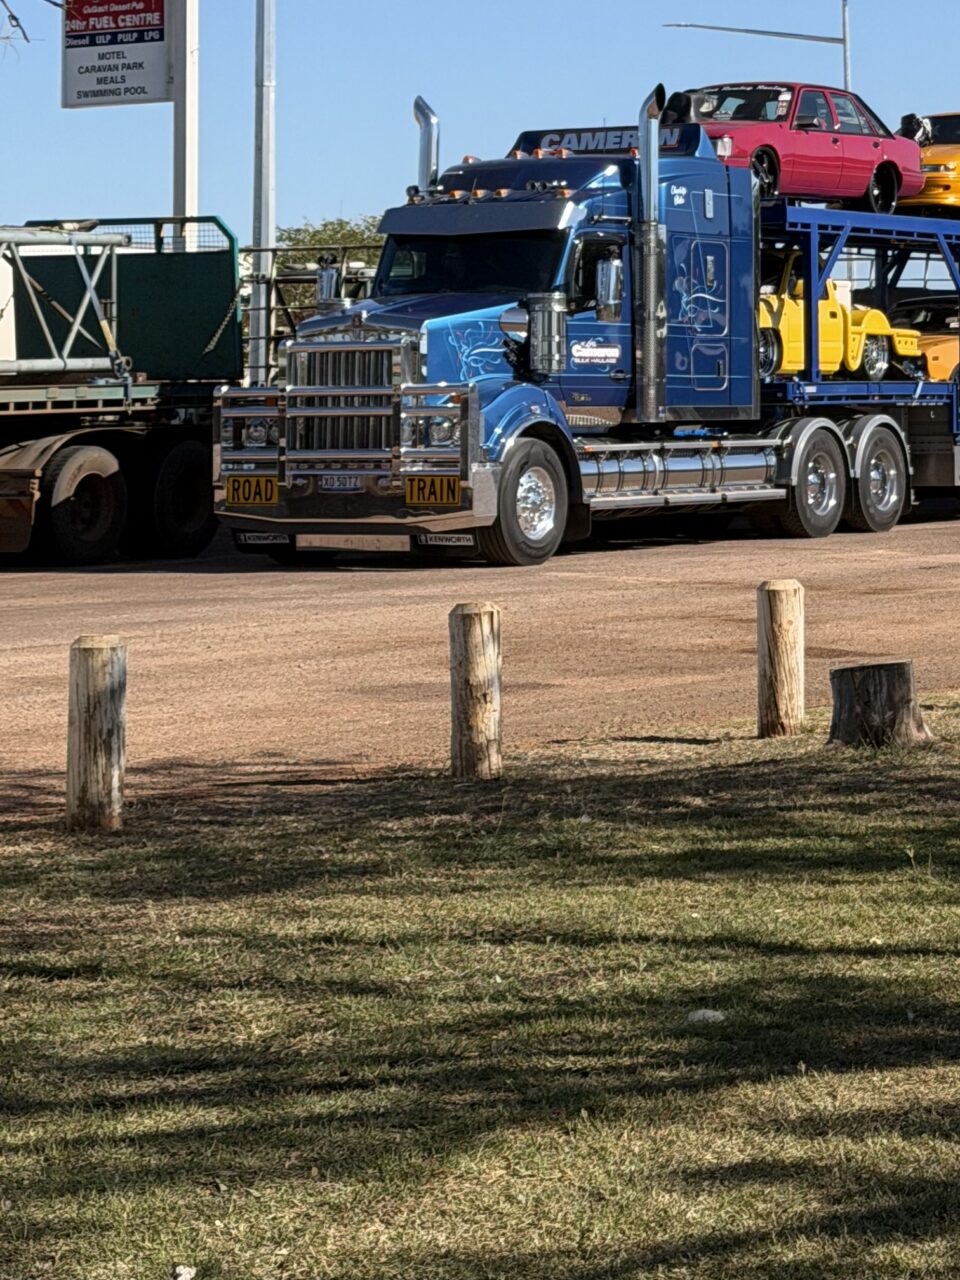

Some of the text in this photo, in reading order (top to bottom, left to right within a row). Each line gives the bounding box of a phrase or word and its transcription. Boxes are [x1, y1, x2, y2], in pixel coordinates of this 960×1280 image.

[131, 2, 144, 10] Pub
[65, 12, 160, 31] 24hr FUEL CENTRE
[65, 30, 160, 46] Diesel ULP PULP LPG
[97, 51, 127, 60] MOTEL
[77, 61, 145, 74] CARAVAN PARK
[96, 75, 127, 85] MEALS
[76, 86, 148, 99] SWIMMING POOL
[540, 128, 680, 150] CAMERN
[232, 478, 274, 503] ROAD
[407, 477, 458, 502] TRAIN
[247, 534, 289, 542] KENWORTH
[428, 535, 472, 544] KENWORTH
